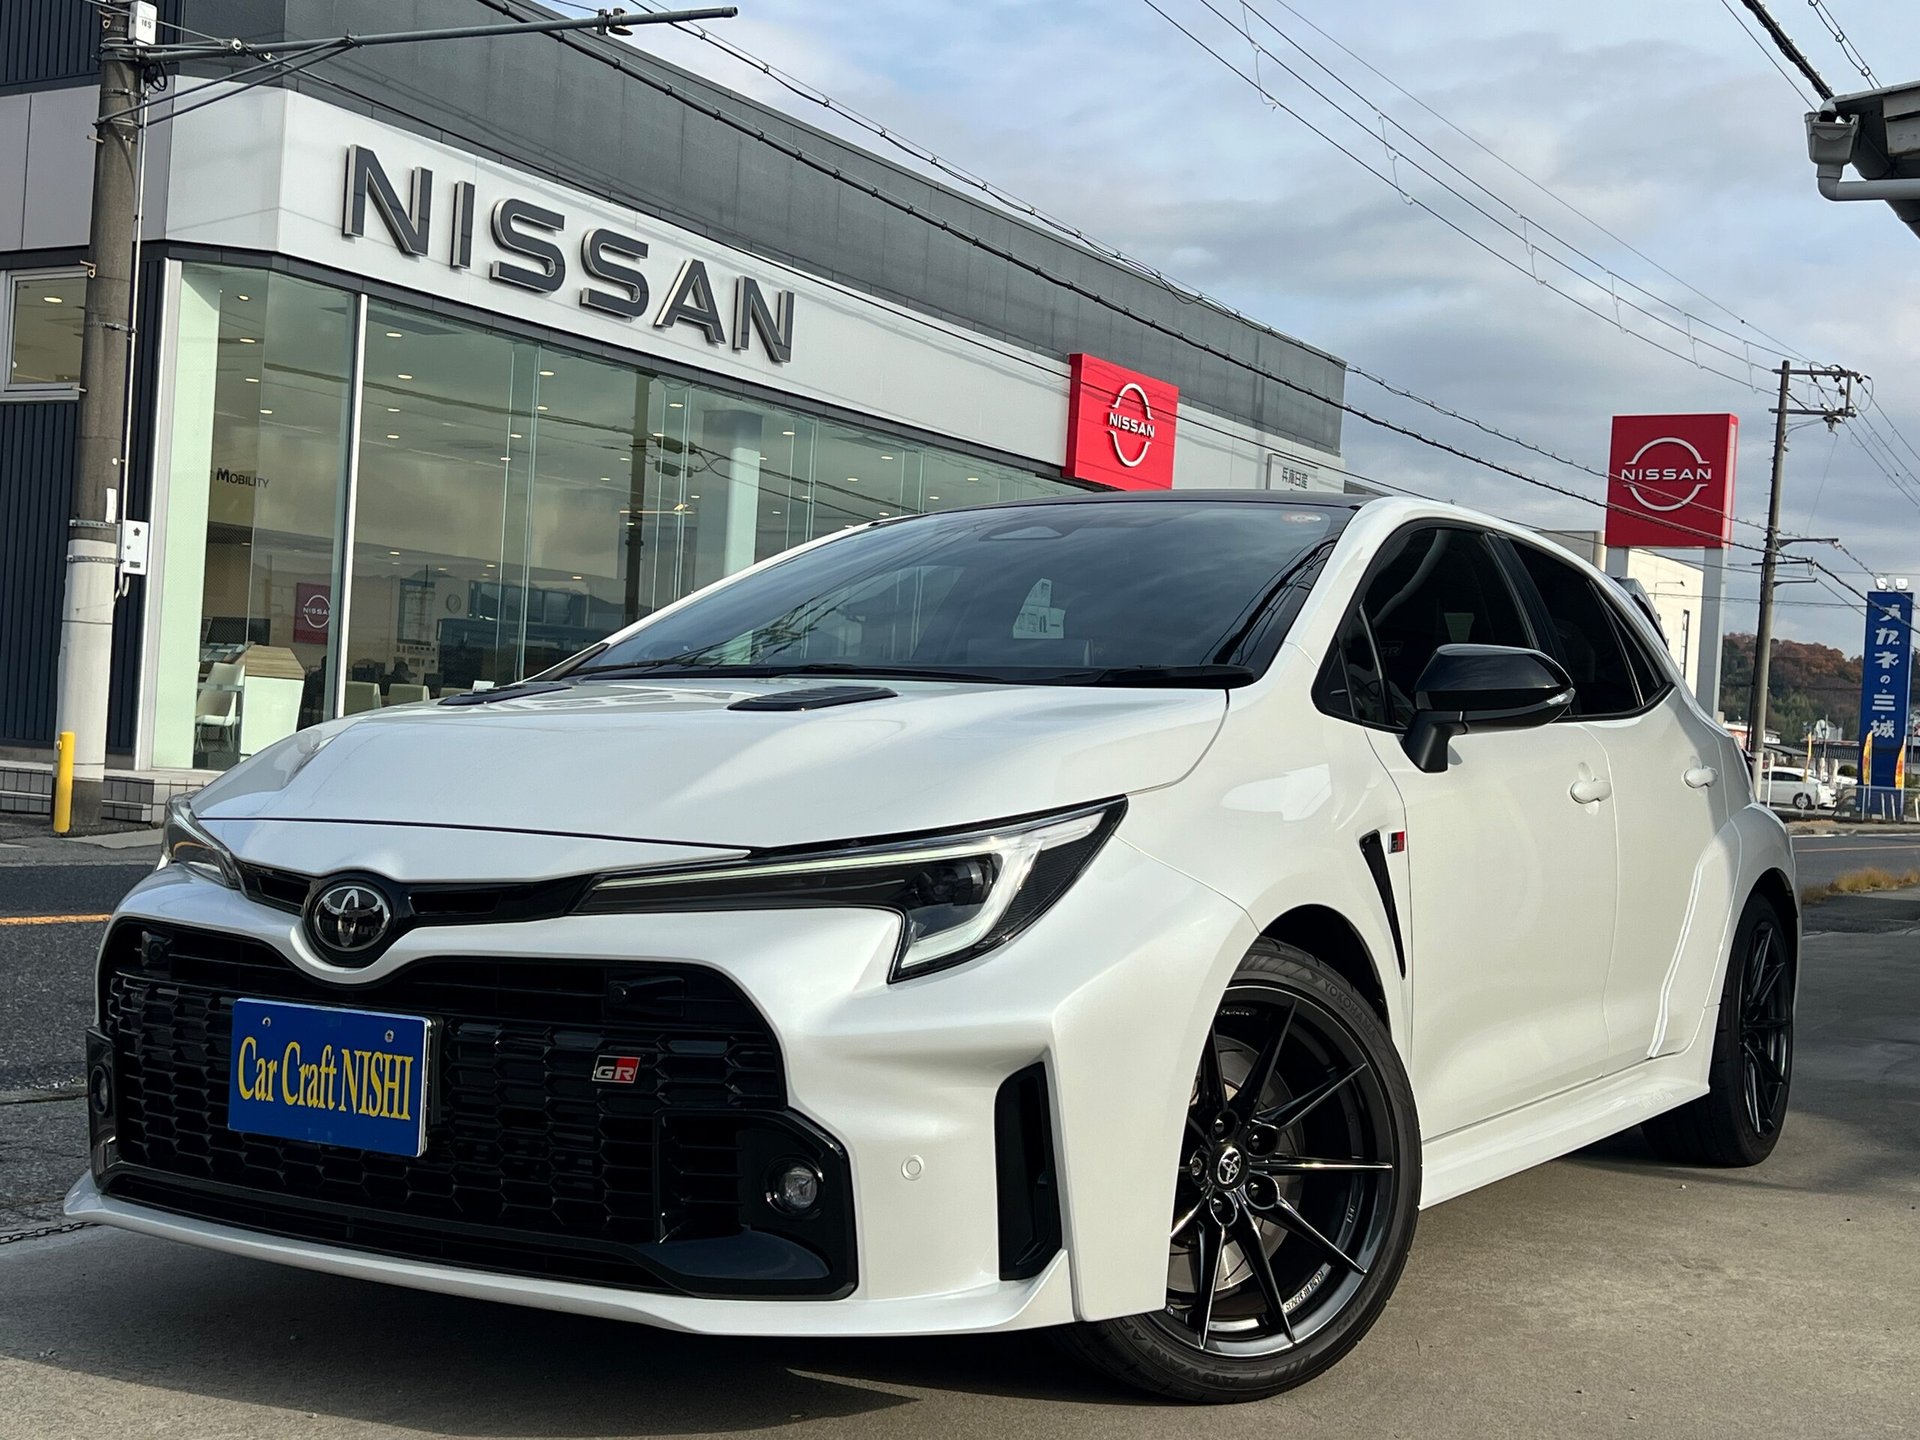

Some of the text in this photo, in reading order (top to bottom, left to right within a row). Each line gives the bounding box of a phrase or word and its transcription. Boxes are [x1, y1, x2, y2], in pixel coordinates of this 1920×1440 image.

[342, 144, 795, 364] NISSAN
[1109, 411, 1155, 438] NISSAN
[1621, 468, 1711, 480] NISSAN
[303, 607, 328, 615] NISSA
[1325, 980, 1377, 1038] YOKOHAMA
[238, 1036, 414, 1120] Car Craft NISHI
[596, 1066, 635, 1080] GR
